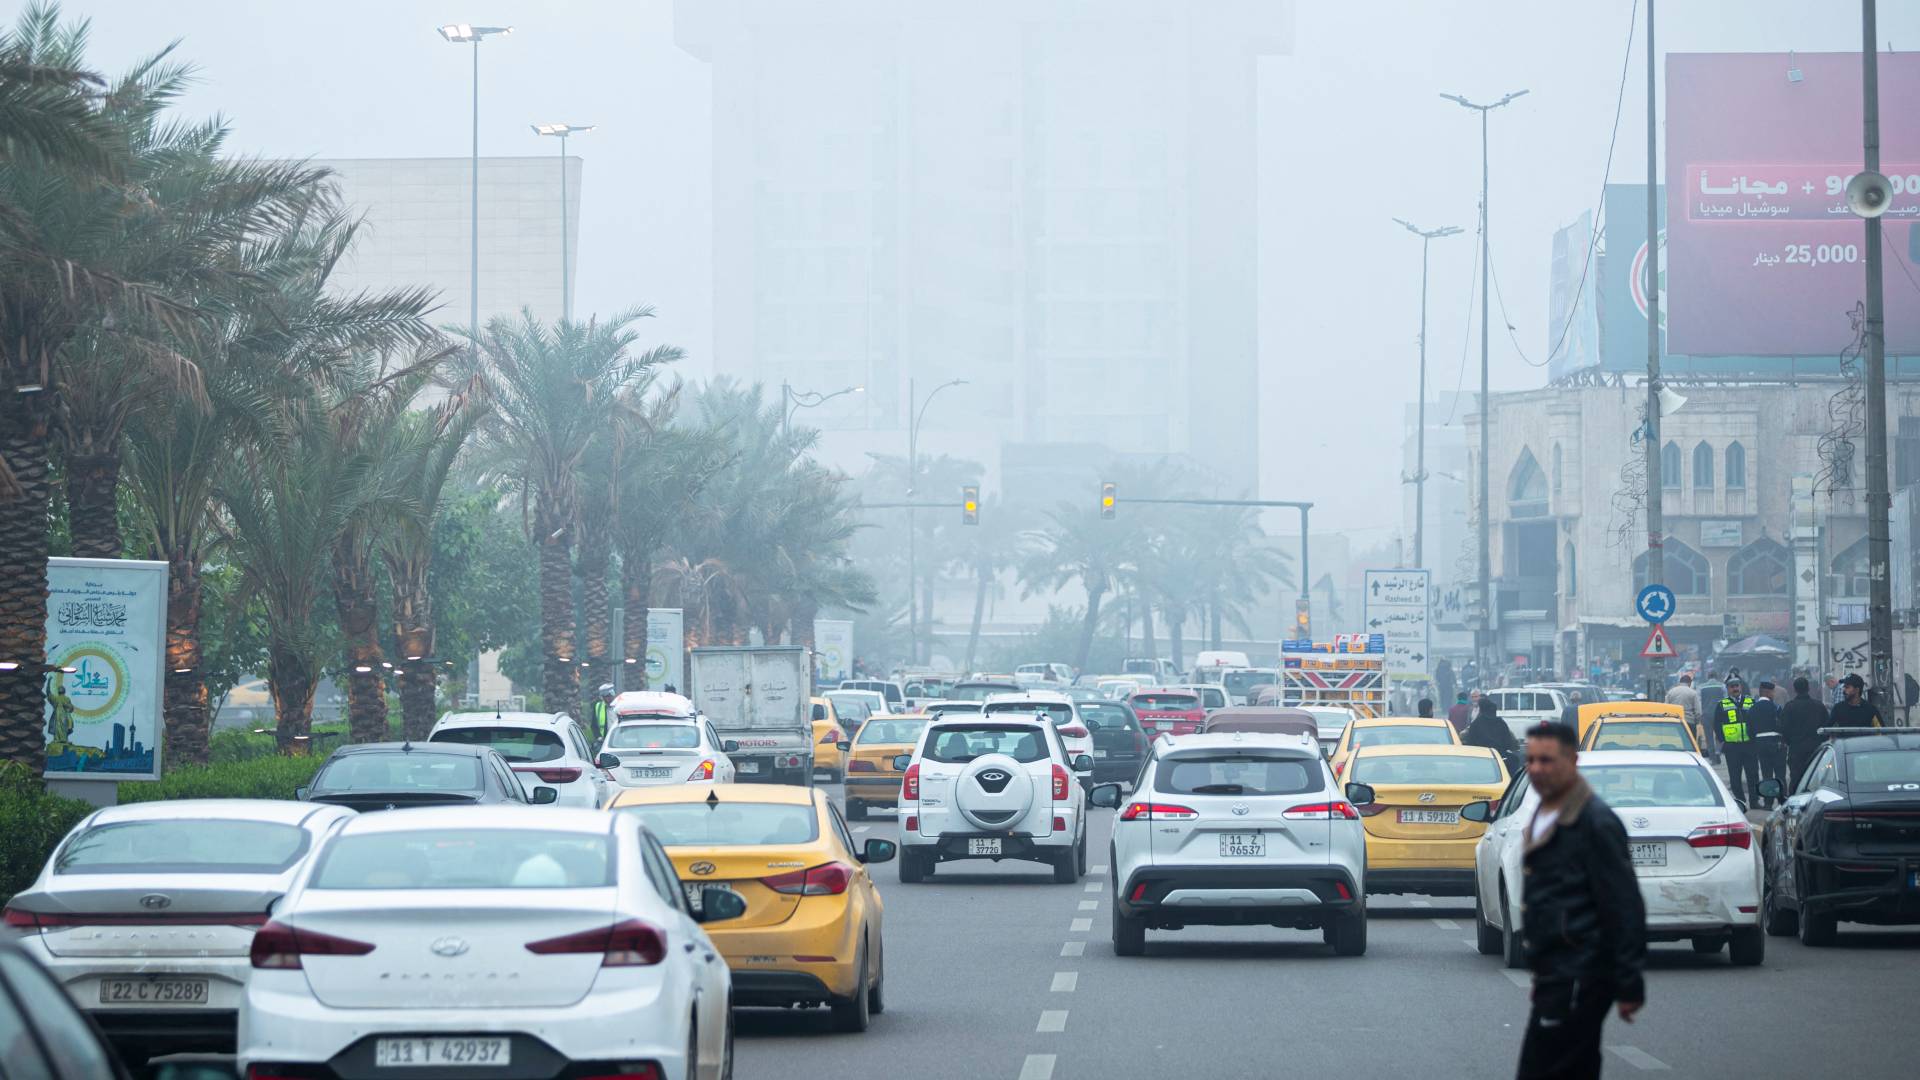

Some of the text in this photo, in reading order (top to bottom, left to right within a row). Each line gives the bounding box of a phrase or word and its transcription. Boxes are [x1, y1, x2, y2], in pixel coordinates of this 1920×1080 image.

[1699, 201, 1790, 217] سوشيال ميديا
[1753, 244, 1857, 267] 25,000 دينار
[1384, 576, 1424, 592] شارع الرشيد
[1410, 611, 1424, 624] شارع
[736, 739, 777, 747] MOTORS
[1403, 811, 1456, 822] 11 A 59128
[1230, 835, 1242, 845] 11
[1251, 835, 1257, 845] Z
[976, 846, 999, 854] 37720
[1230, 845, 1261, 855] 96537
[113, 982, 132, 999] 22
[138, 982, 148, 999] C
[154, 982, 203, 1000] 75289
[391, 1040, 502, 1062] 11 T 42937
